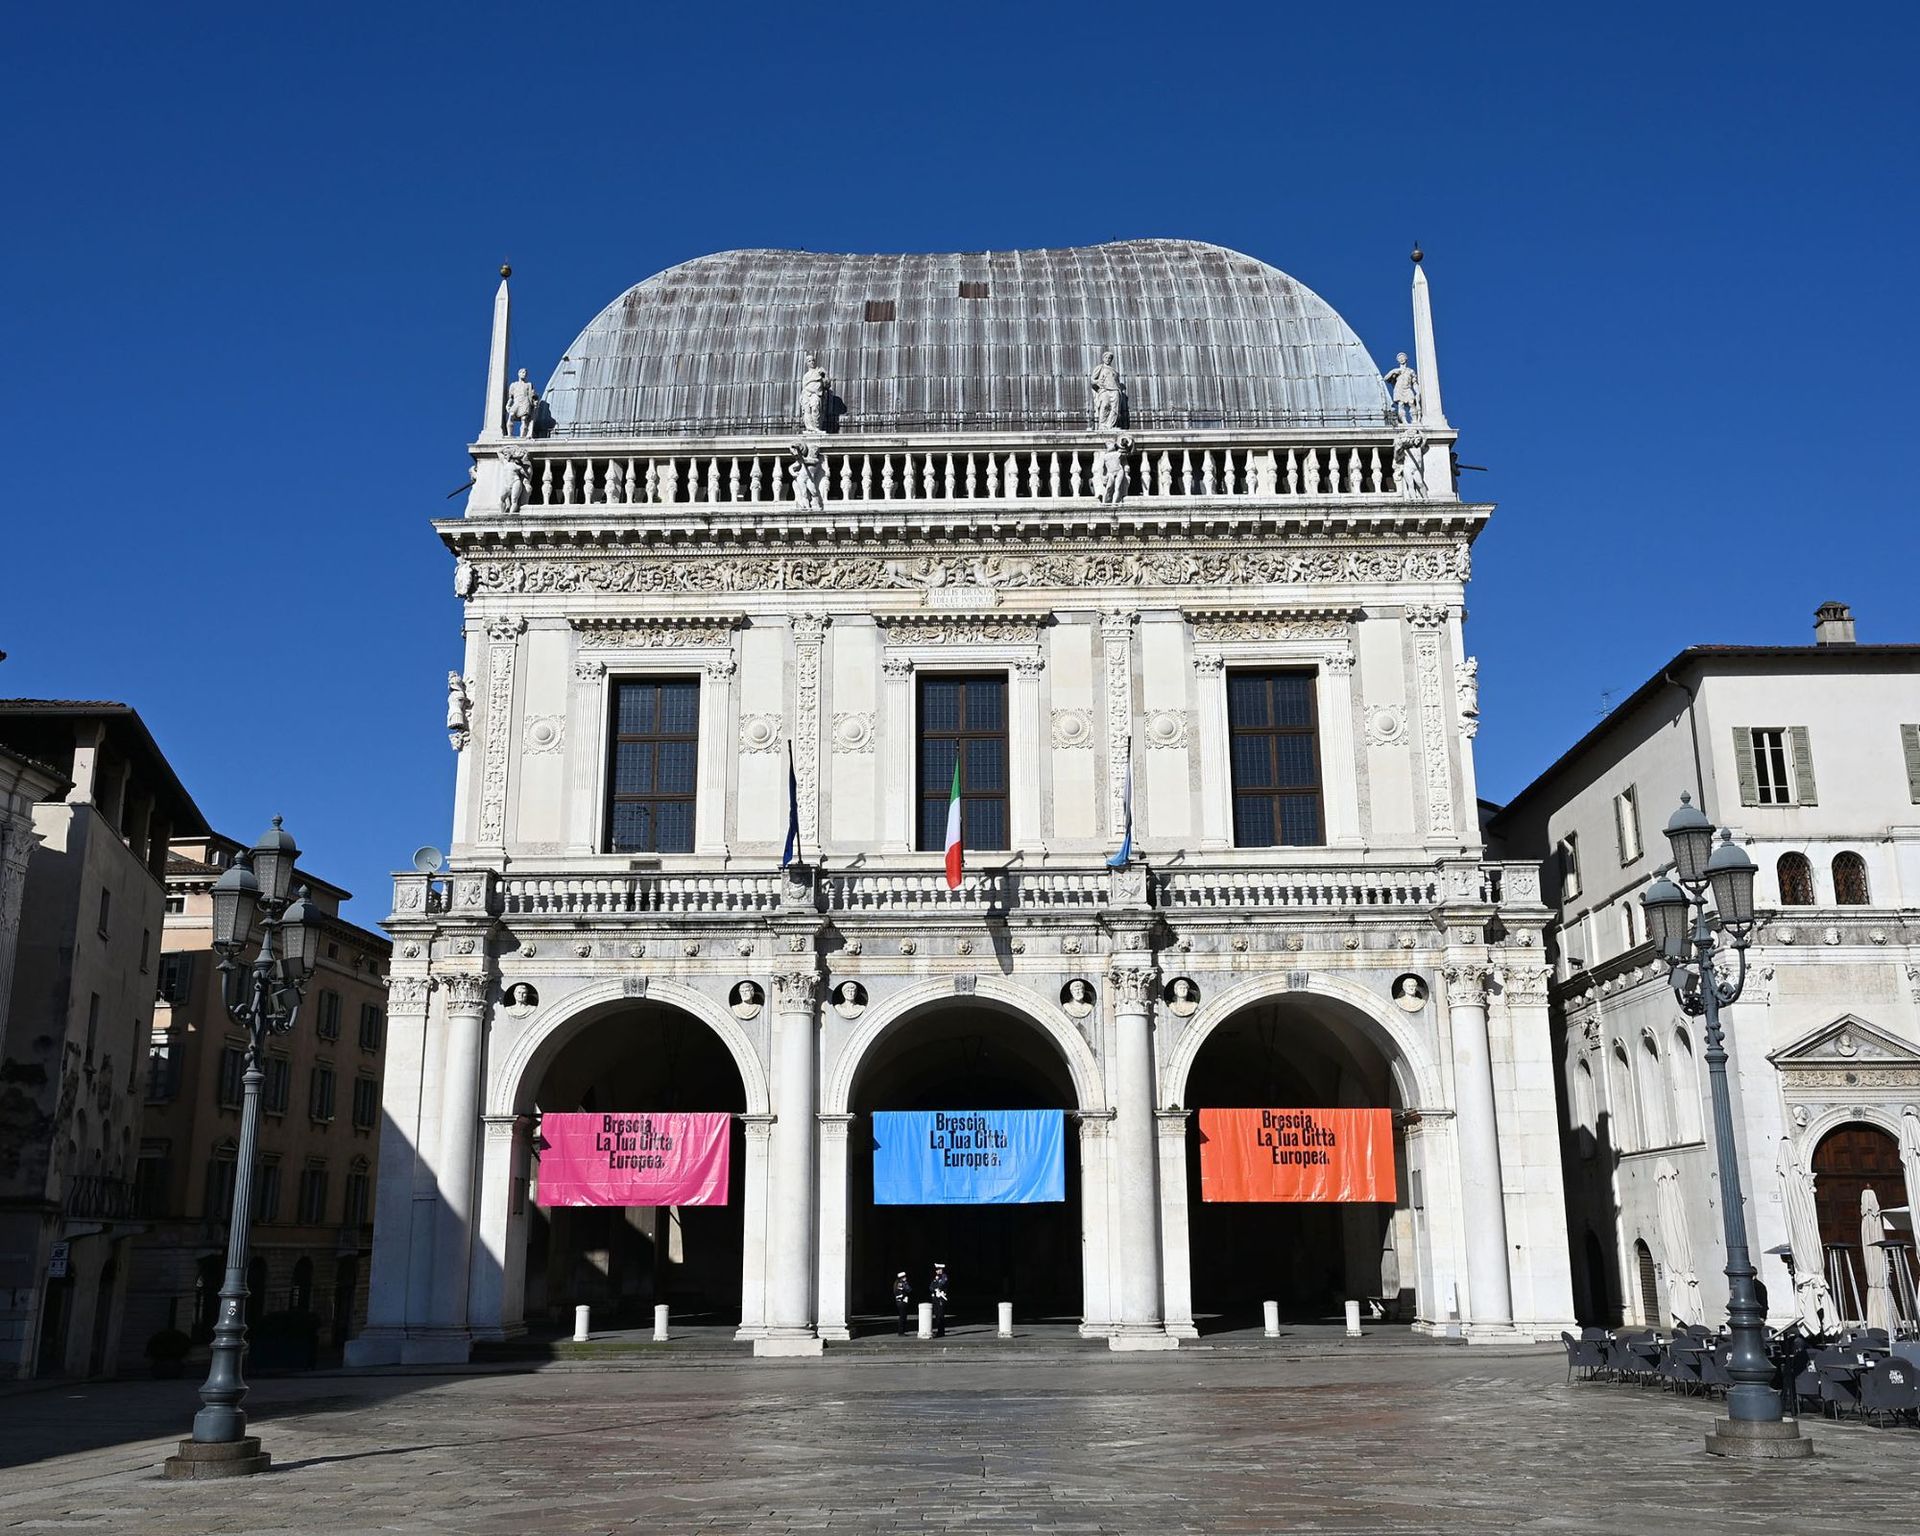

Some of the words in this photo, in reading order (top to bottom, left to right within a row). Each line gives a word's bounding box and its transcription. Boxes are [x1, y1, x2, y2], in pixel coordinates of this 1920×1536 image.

[596, 1132, 611, 1151] La
[615, 1131, 637, 1151] Tua
[930, 1130, 945, 1149] La
[948, 1130, 972, 1149] Tua
[1257, 1128, 1272, 1146] La
[1275, 1128, 1299, 1146] Tua
[1302, 1128, 1336, 1146] Città
